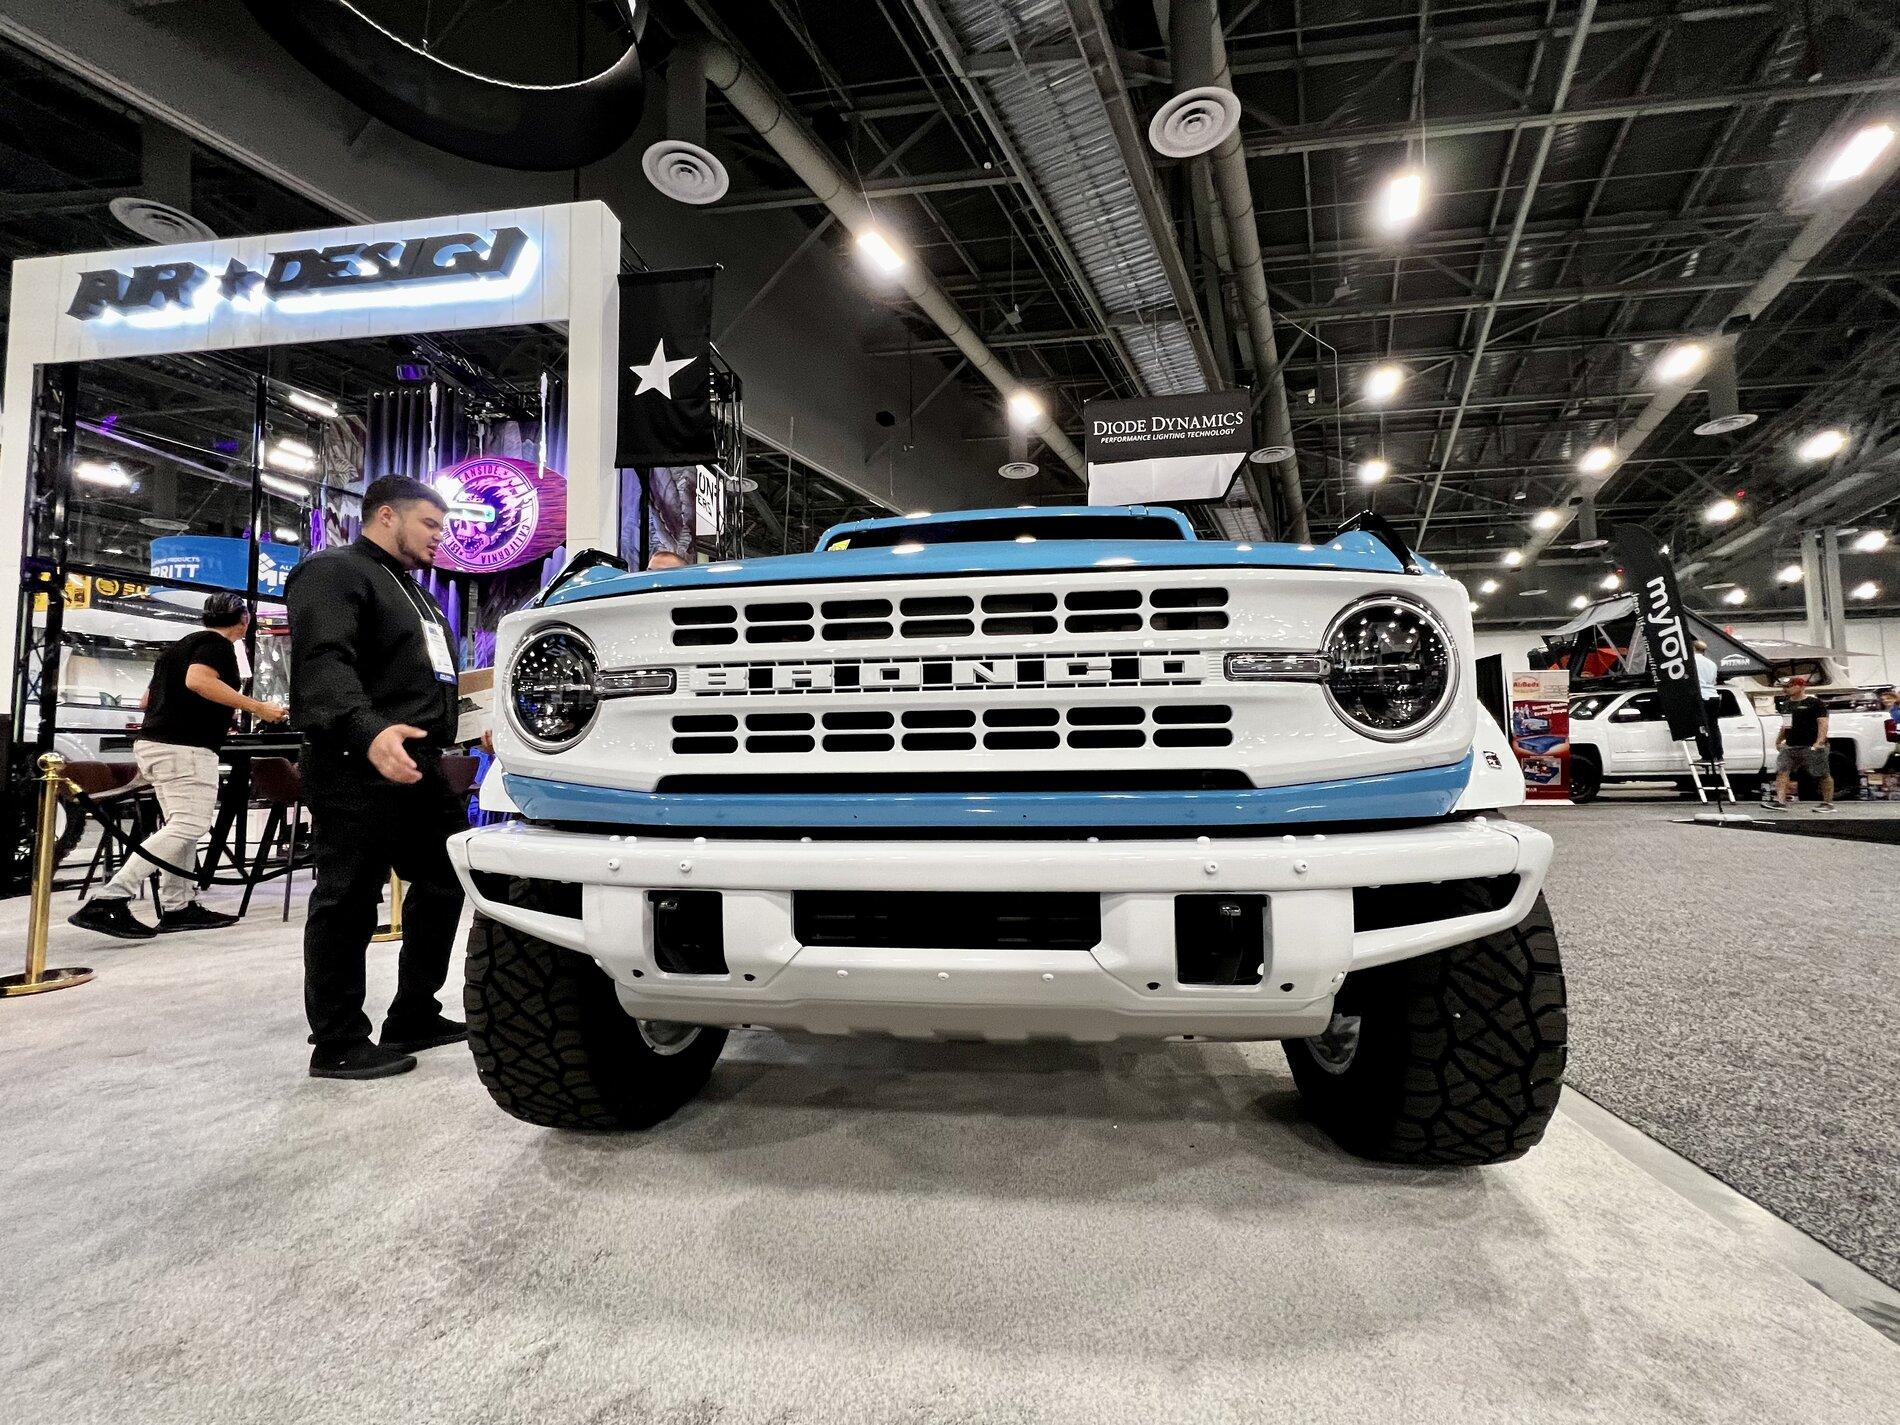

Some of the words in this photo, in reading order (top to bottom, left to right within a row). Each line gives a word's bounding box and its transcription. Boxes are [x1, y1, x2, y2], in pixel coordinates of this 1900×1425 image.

[1093, 419, 1147, 436] DIODE
[1151, 411, 1244, 432] DYNAMICS
[1100, 434, 1151, 444] PERFORMANCE
[1152, 432, 1186, 441] LIGHTING
[1187, 428, 1236, 438] TECHNOLOGY
[481, 524, 531, 565] CALIFORNIA
[691, 653, 1206, 692] BRONCO
